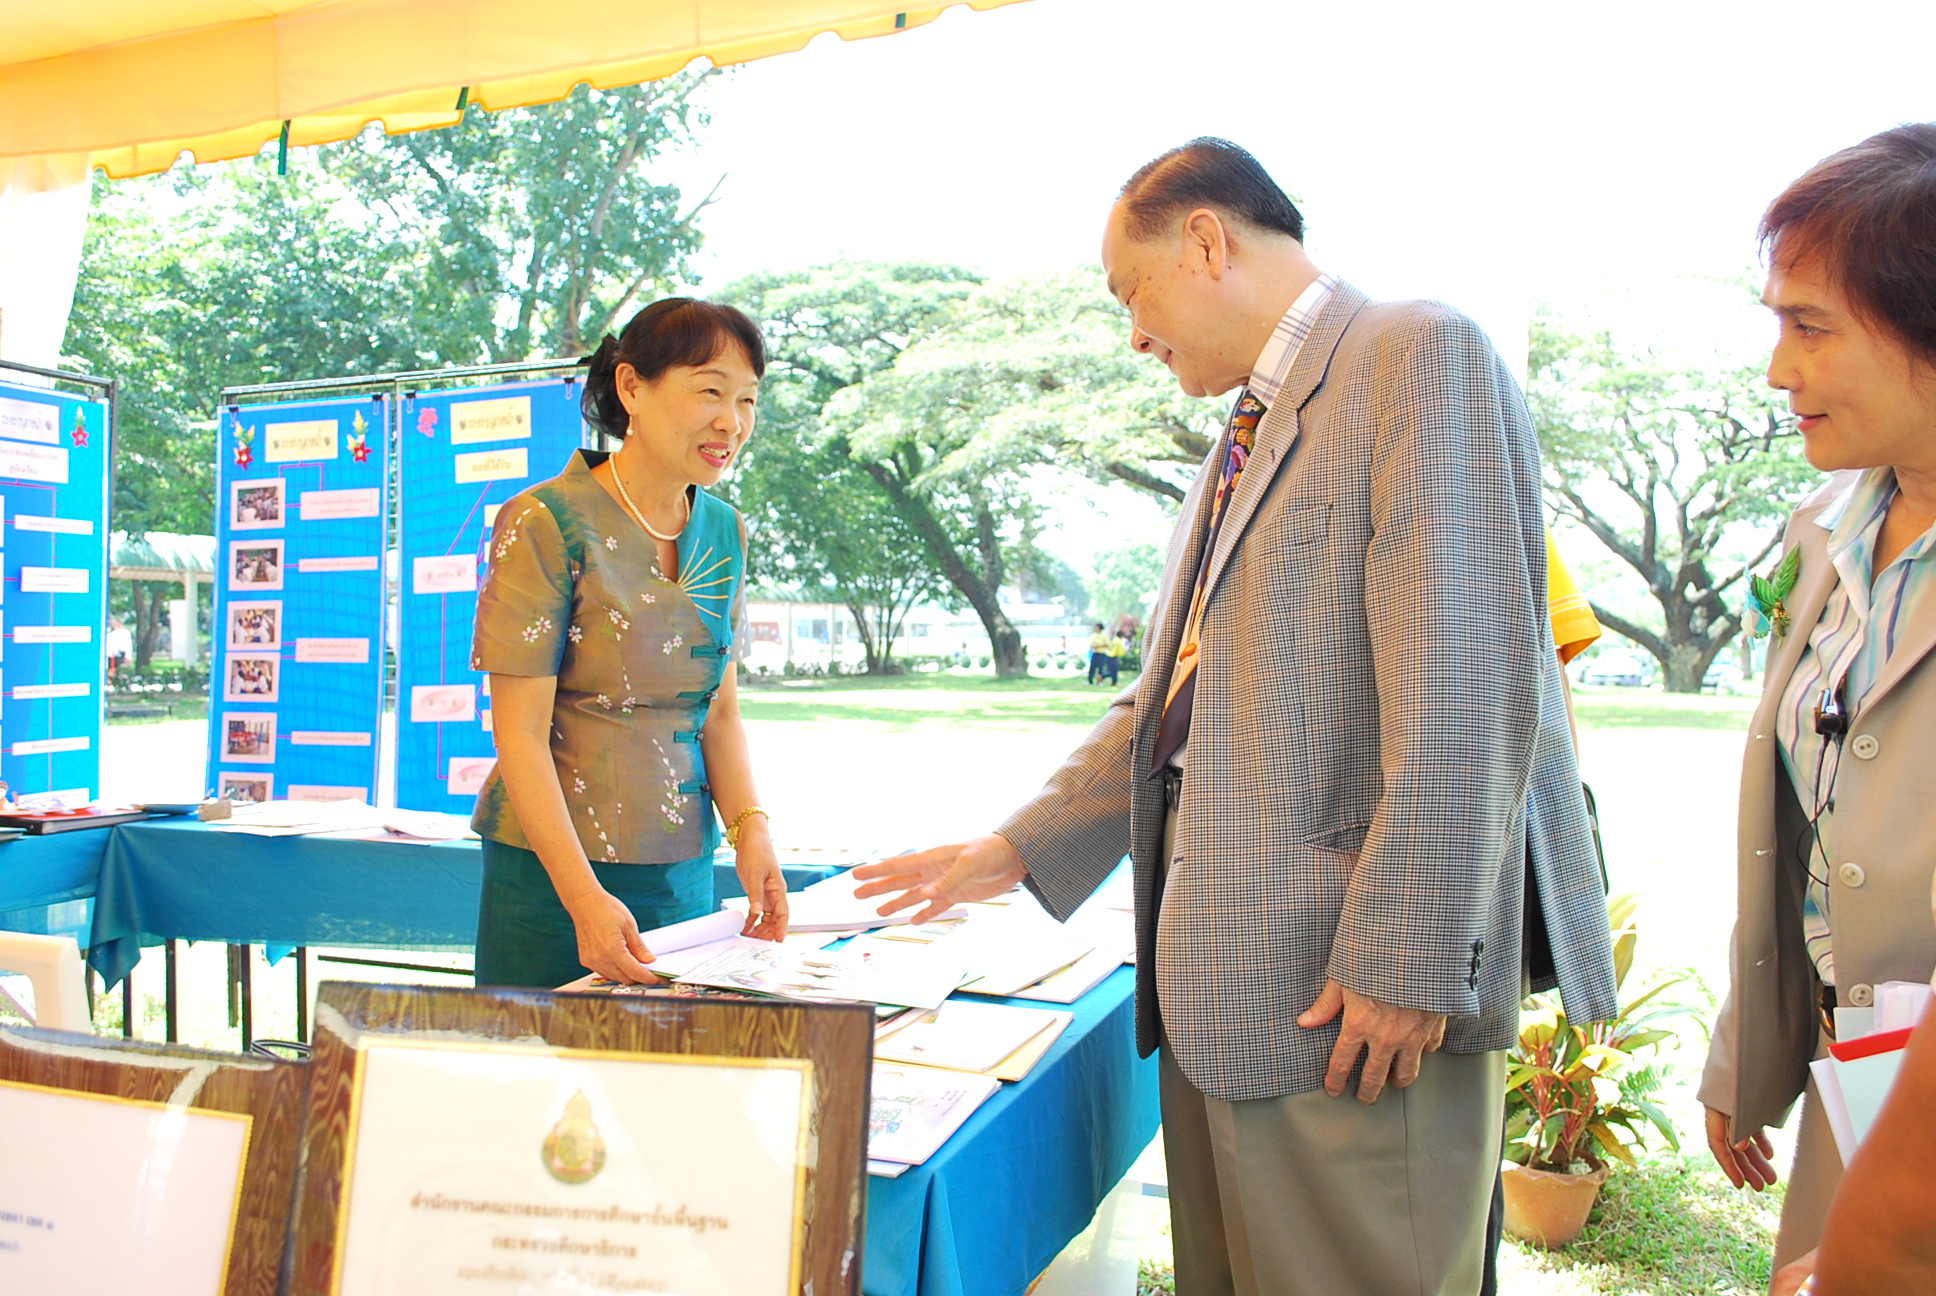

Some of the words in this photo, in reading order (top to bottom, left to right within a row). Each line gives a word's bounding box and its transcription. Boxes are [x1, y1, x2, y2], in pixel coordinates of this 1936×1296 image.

[491, 1235, 638, 1259] กระทรวงศึกษาธิการ
